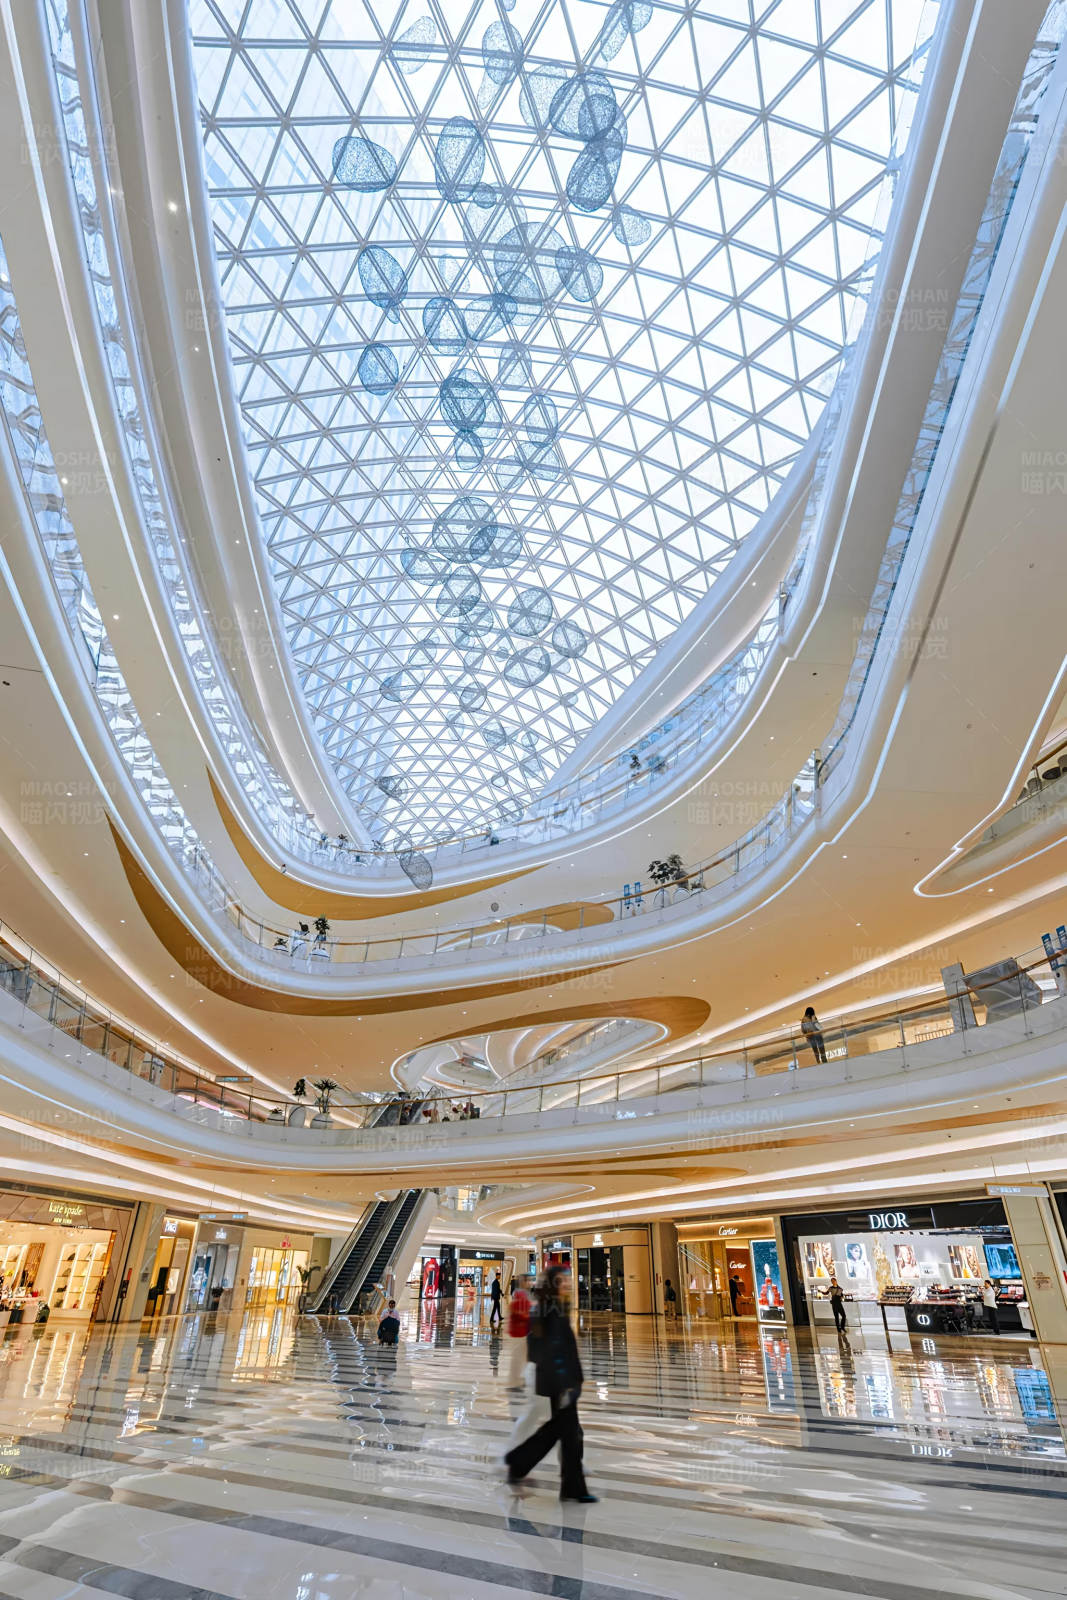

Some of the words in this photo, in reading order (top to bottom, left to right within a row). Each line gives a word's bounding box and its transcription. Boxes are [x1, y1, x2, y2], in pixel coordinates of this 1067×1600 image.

[868, 1212, 910, 1229] DIOR
[718, 1225, 739, 1236] Cartier
[729, 1260, 747, 1269] Cartier
